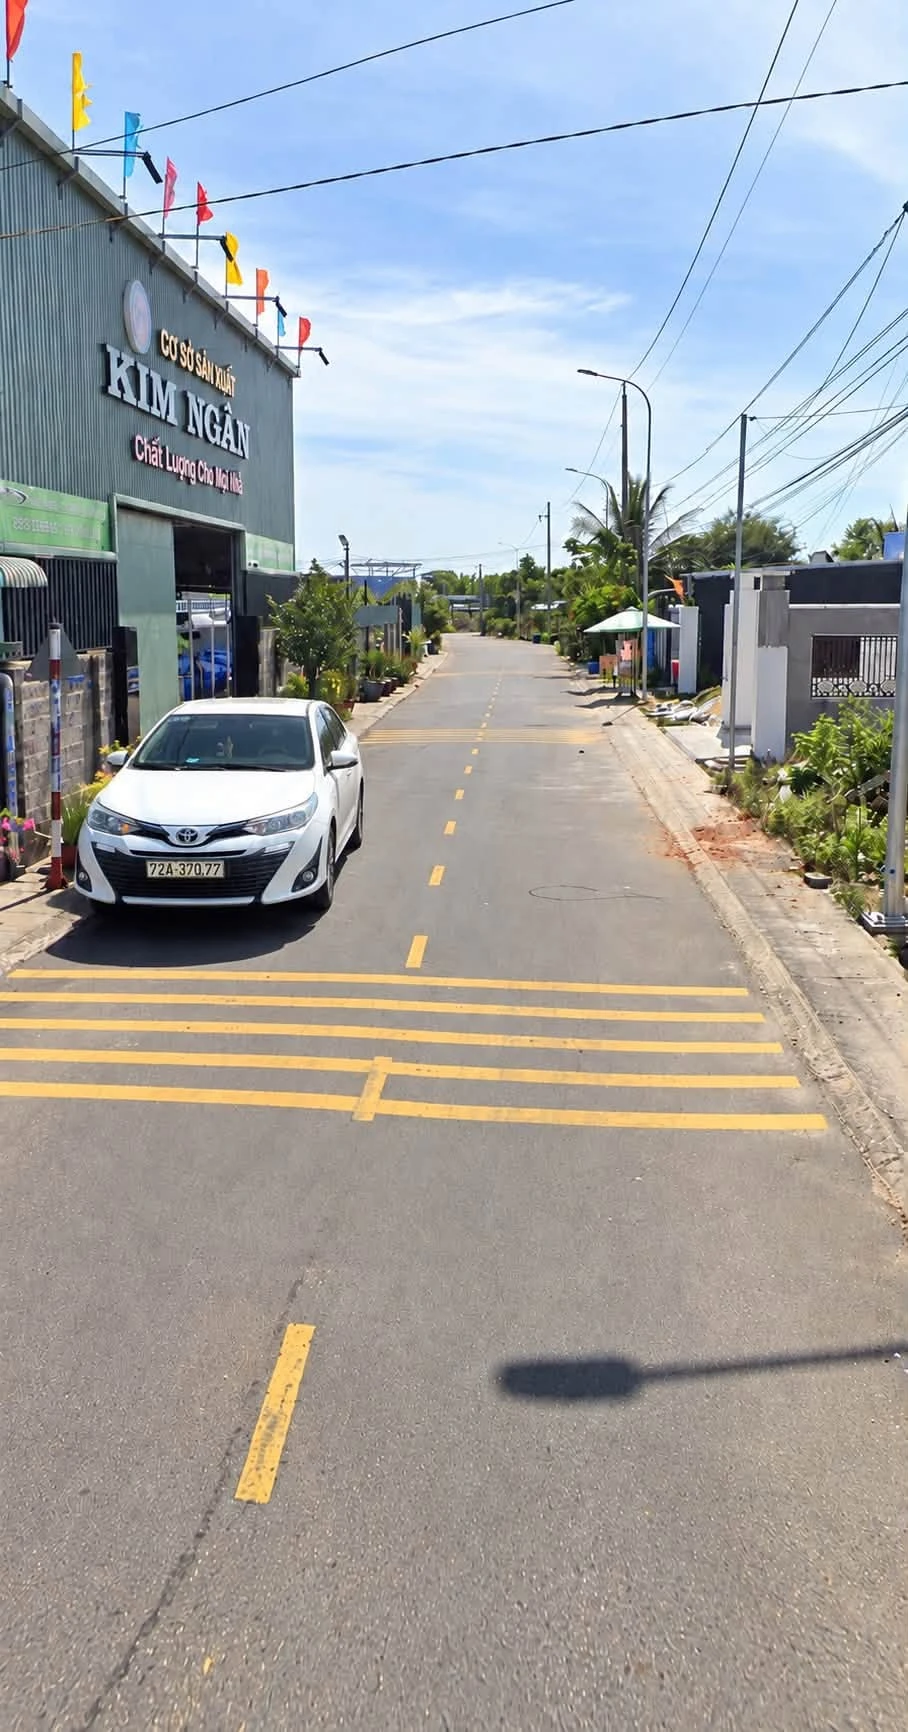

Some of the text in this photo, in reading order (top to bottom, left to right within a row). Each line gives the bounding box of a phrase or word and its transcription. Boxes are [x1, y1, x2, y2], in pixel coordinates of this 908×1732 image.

[161, 328, 178, 361] CƠ
[179, 339, 194, 372] SỞ
[196, 349, 214, 384] SẢN
[105, 344, 251, 459] KIM NGÂN
[134, 433, 163, 468] Chất
[166, 445, 196, 485] Lượng
[198, 460, 214, 485] Cho
[215, 467, 229, 494] Mọi
[149, 863, 221, 876] 72A-370.77
